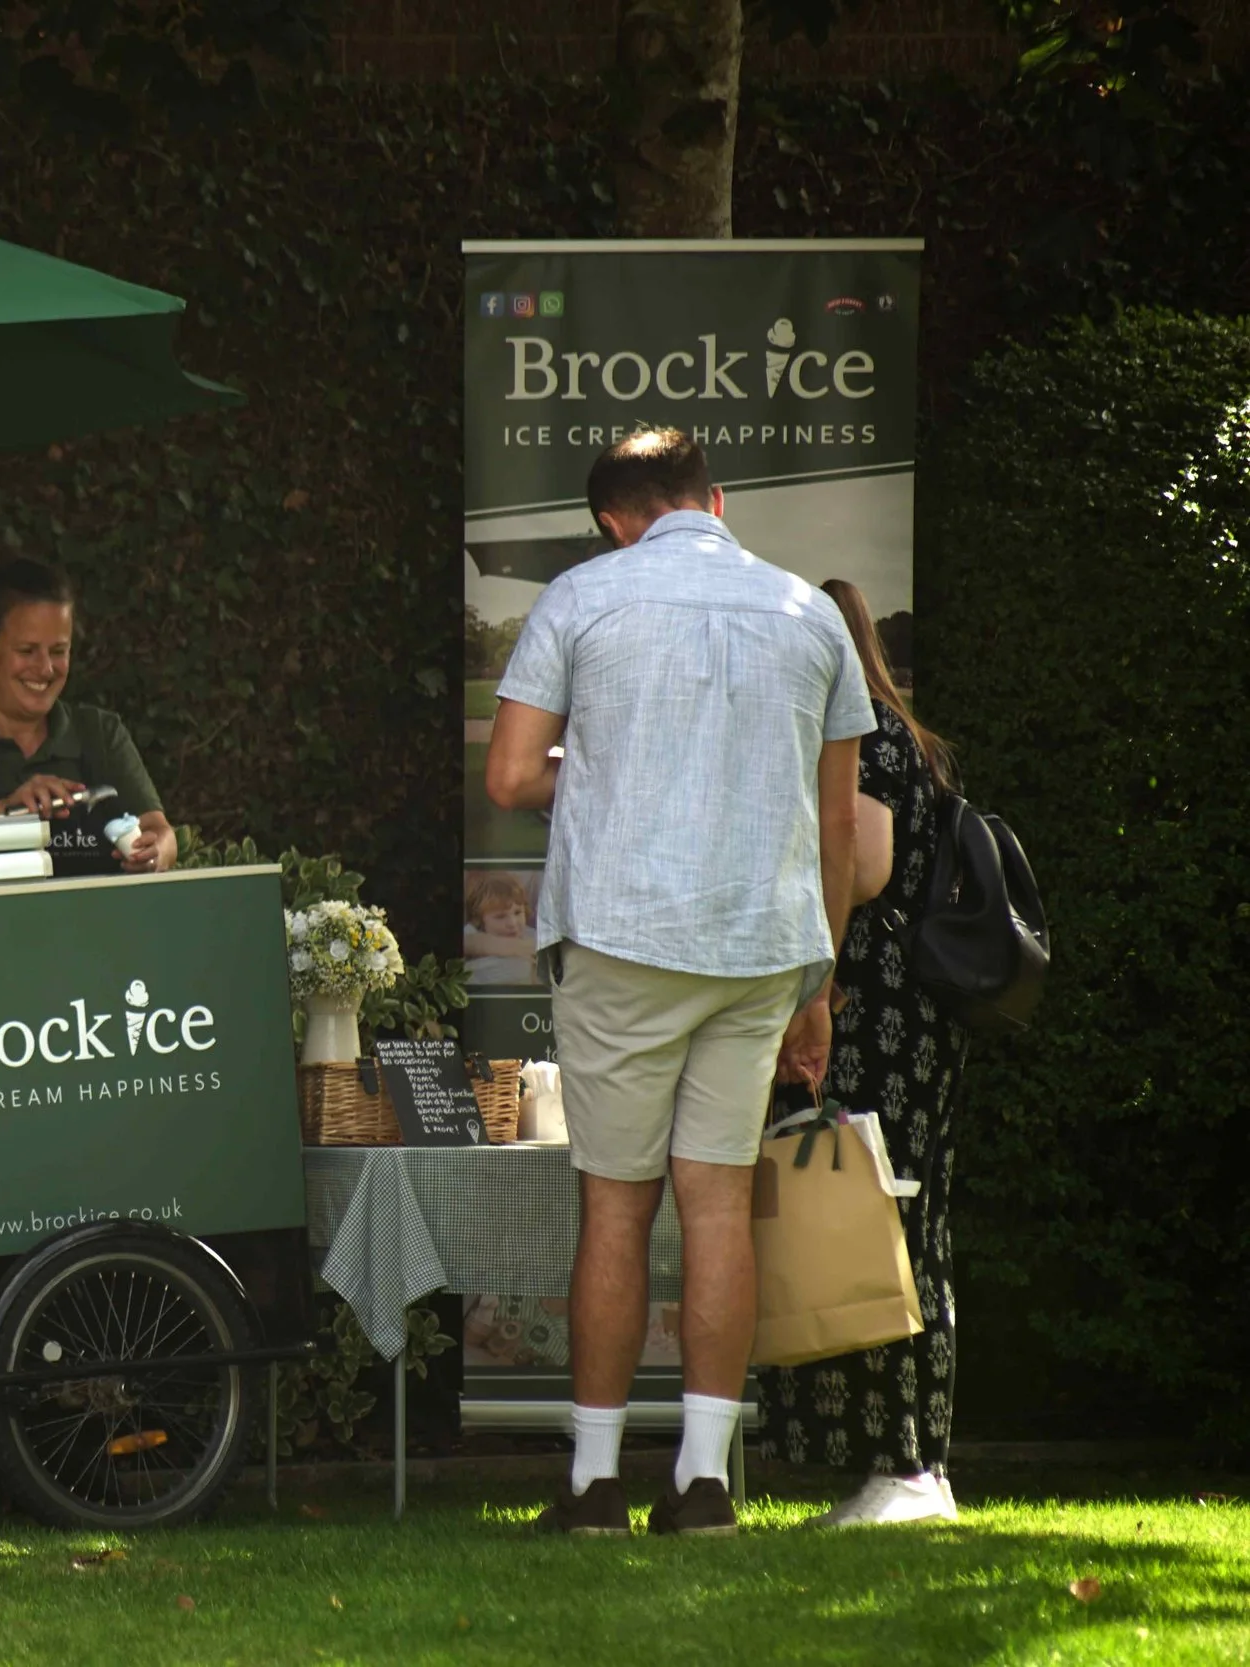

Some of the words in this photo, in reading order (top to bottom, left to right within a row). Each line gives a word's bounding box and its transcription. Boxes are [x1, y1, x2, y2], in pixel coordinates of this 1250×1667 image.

[505, 333, 748, 401] Brock
[504, 425, 551, 446] ICE
[693, 424, 877, 446] HAPPINESS
[521, 1012, 552, 1033] Ou
[415, 1049, 425, 1057] to
[443, 1049, 456, 1059] for
[78, 1071, 223, 1101] HAPPINESS
